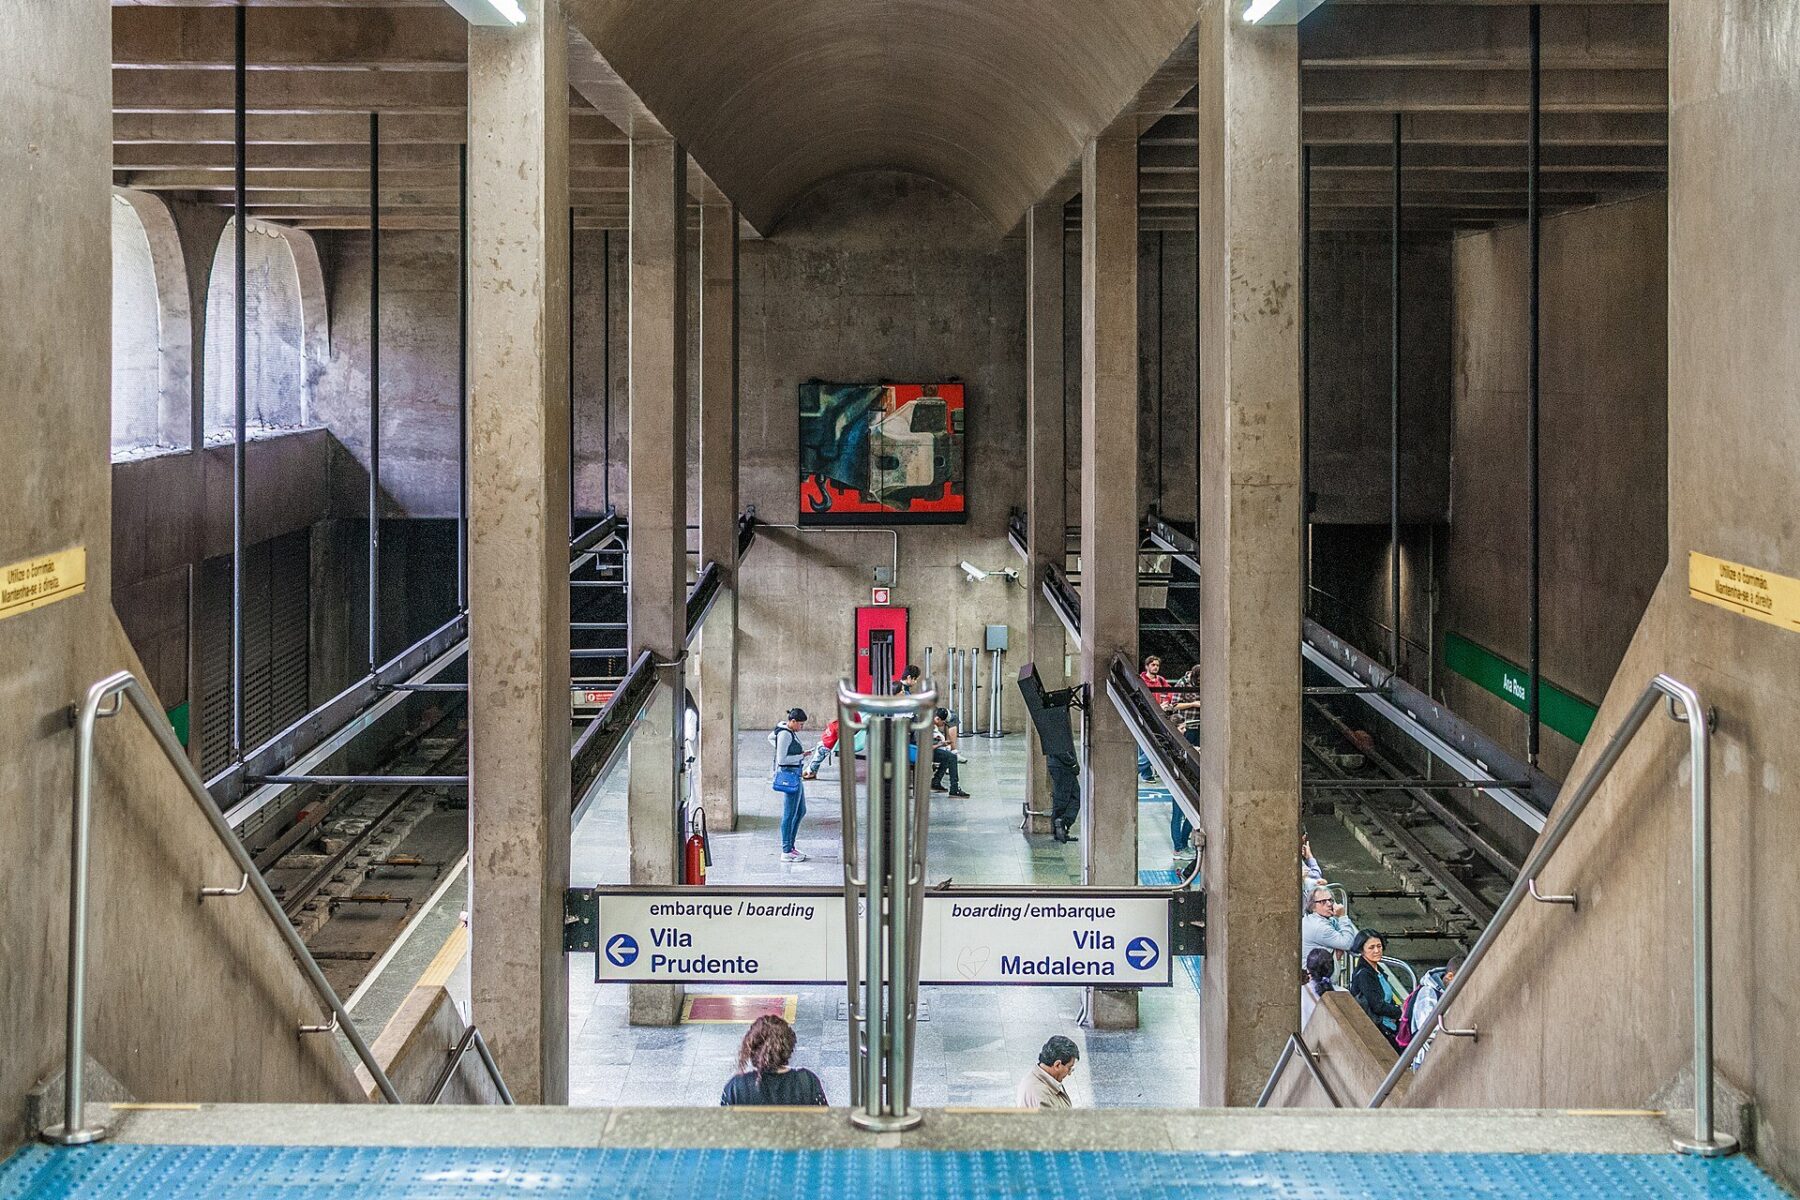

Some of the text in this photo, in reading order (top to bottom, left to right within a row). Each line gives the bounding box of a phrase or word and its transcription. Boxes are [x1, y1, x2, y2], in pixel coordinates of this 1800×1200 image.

[1503, 673, 1525, 700] Ana Rosa
[649, 901, 733, 919] embarque
[650, 927, 692, 947] Vila
[1072, 930, 1115, 950] Vila
[651, 954, 759, 974] Prudente
[1001, 955, 1115, 976] Madalena
